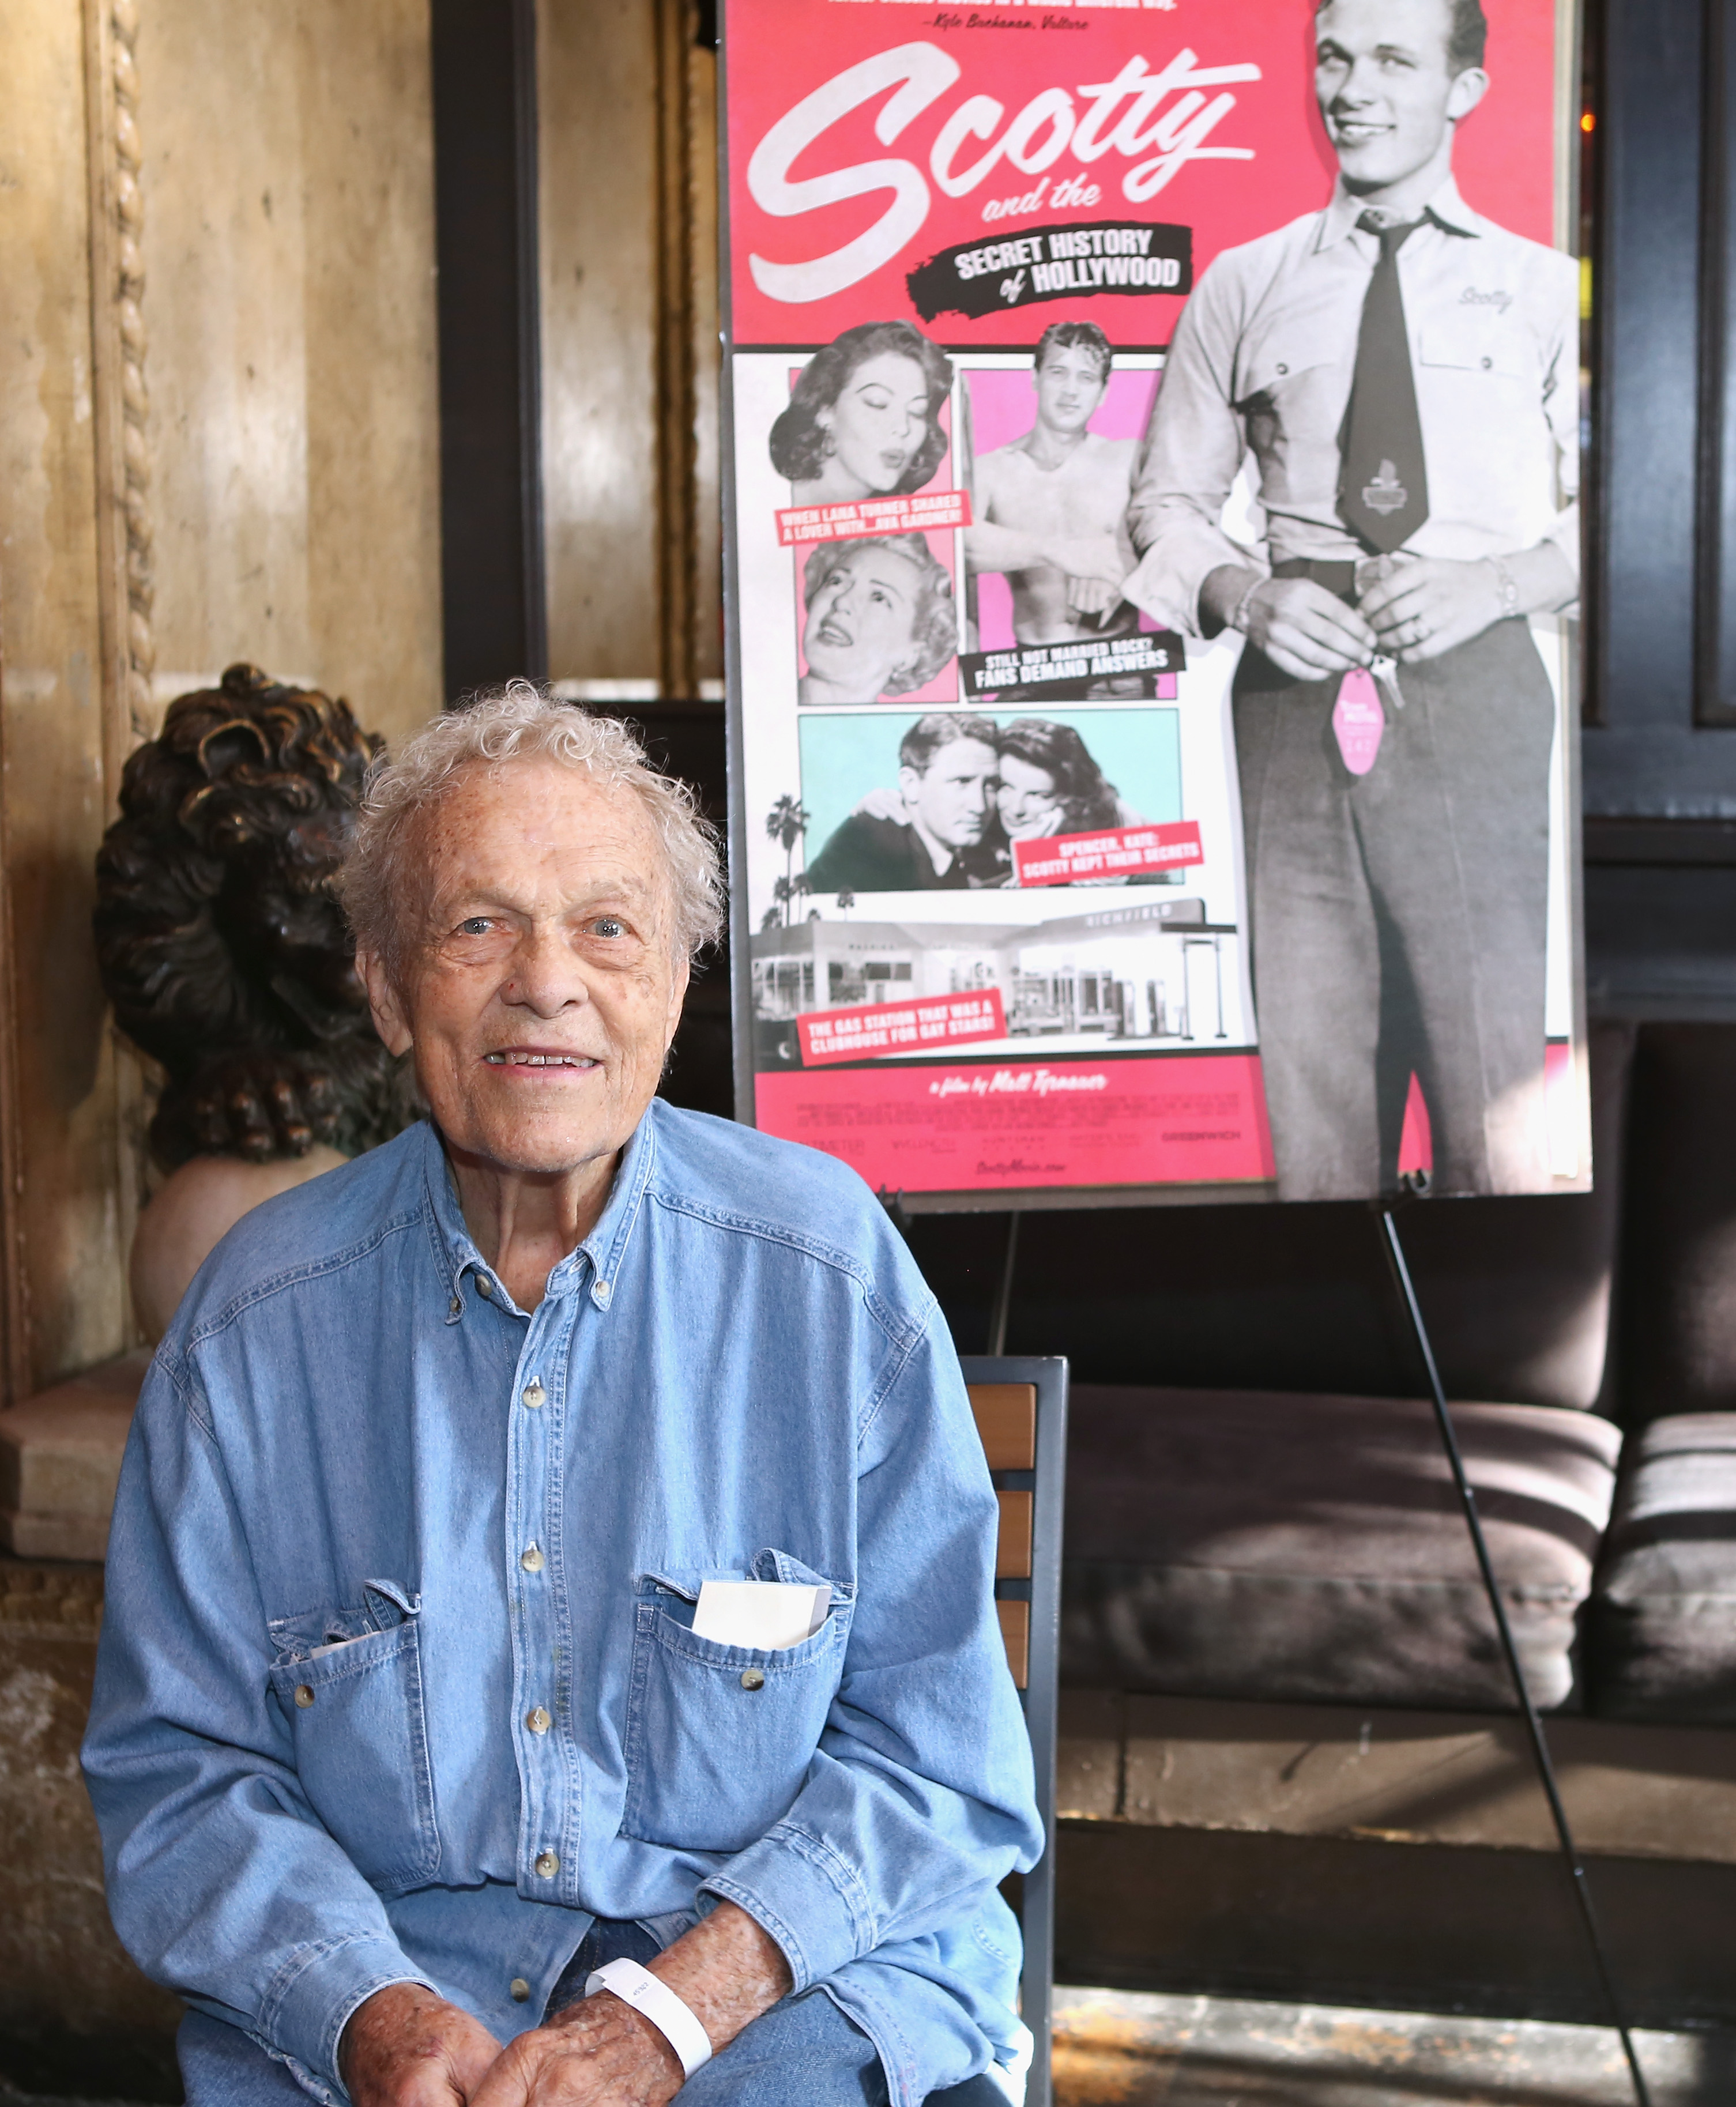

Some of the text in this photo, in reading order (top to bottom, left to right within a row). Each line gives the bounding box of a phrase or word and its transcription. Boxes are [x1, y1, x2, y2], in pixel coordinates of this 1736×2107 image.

[747, 41, 1261, 303] Scotty
[982, 172, 1101, 223] and the
[954, 229, 1153, 280] SECRET HISTORY
[999, 257, 1181, 304] of HOLLYWOOD
[780, 493, 962, 526] WHEN LANA TURNER SHARED
[783, 527, 794, 541] A
[794, 523, 833, 540] LOVER
[974, 649, 1168, 689] FANS DEMAND ANSWERS
[985, 653, 1020, 670] STILL
[1022, 649, 1049, 665] NOT
[1049, 642, 1109, 661] MARRIED
[1022, 842, 1200, 879] SCOTTY KEPT THEIR SECRETS
[808, 998, 992, 1038] THE GAS STATION THAT WAS A
[811, 1030, 888, 1054] CLUBHOUSE
[890, 1026, 917, 1043] FOR
[919, 1022, 947, 1039] GAY
[929, 1081, 939, 1094] a
[939, 1076, 971, 1098] film
[971, 1075, 989, 1097] by
[988, 1069, 1033, 1092] Matt
